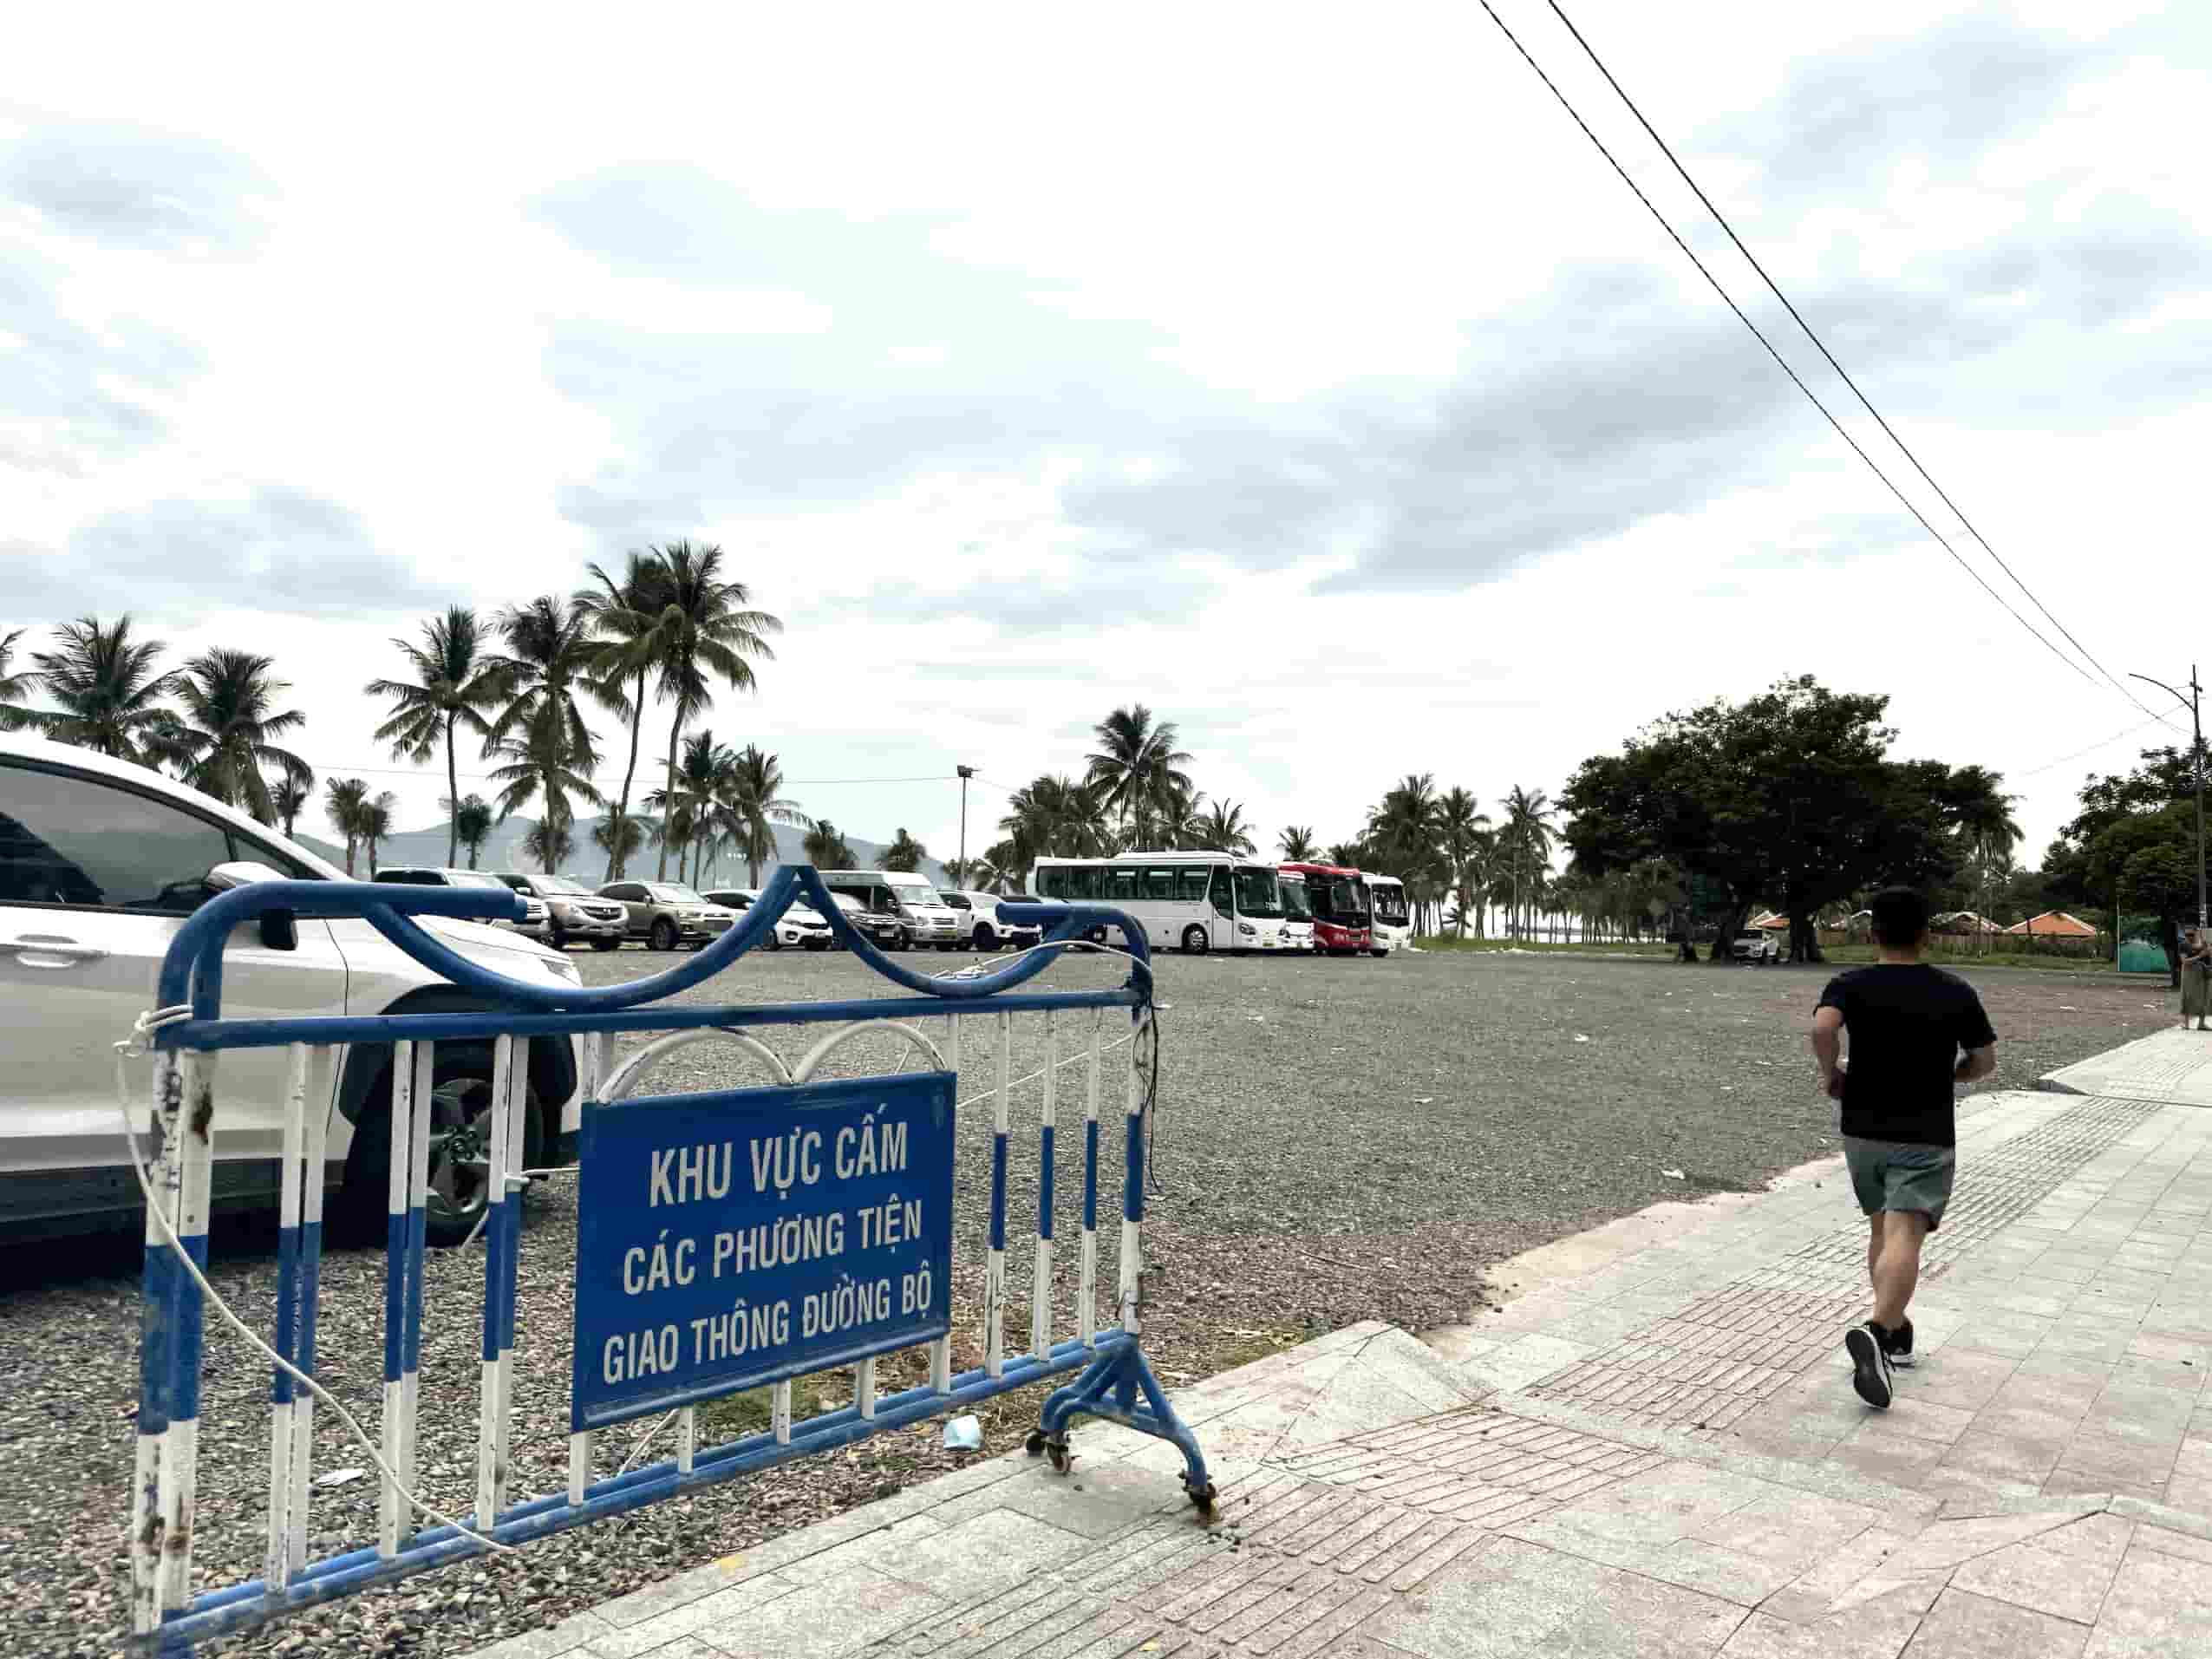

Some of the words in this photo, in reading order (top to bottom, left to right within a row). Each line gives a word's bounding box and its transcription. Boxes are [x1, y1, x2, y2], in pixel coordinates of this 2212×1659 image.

[649, 1142, 733, 1208] KHU
[749, 1127, 822, 1200] VỰC
[834, 1103, 908, 1180] CẤM
[623, 1229, 695, 1296] CÁC
[713, 1212, 845, 1278] PHƯƠNG
[858, 1192, 923, 1255] TIỆN
[604, 1324, 678, 1385] GIAO
[690, 1298, 790, 1364] THÔNG
[802, 1271, 891, 1339] ĐƯỜNG
[901, 1259, 932, 1319] BỘ
